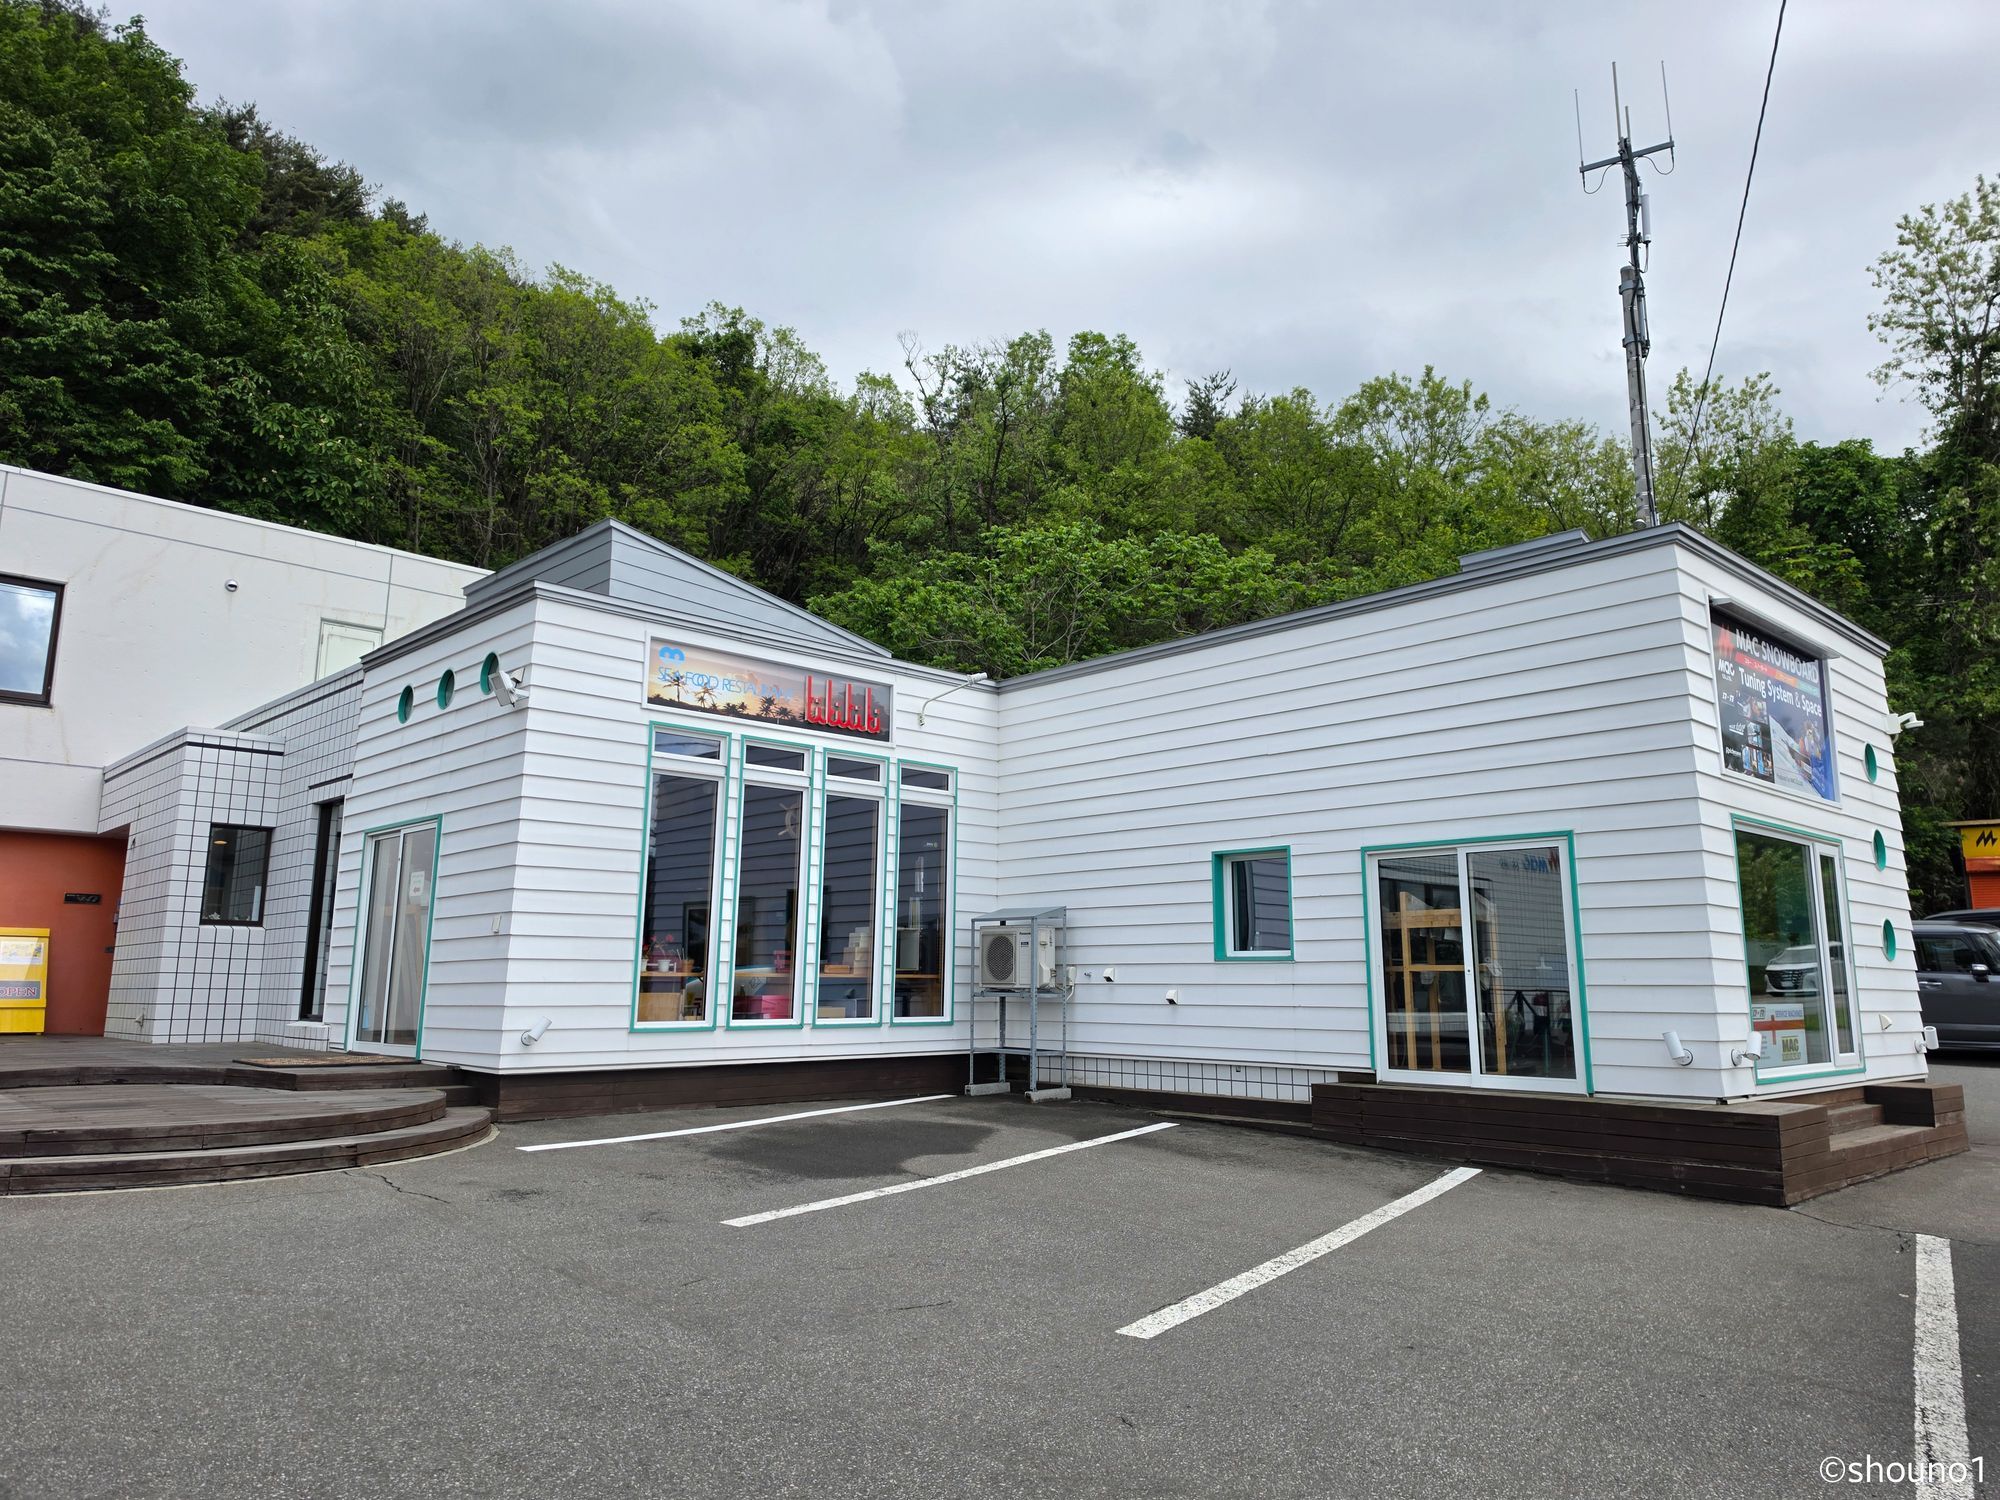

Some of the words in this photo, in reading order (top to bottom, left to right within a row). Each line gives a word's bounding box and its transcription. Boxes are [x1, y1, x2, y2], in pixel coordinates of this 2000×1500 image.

[1735, 629, 1760, 656] MAC
[1761, 641, 1819, 683] SNOWBOARD
[1738, 666, 1767, 699] Tuning
[1767, 679, 1794, 703] System
[1795, 691, 1801, 708] &
[1801, 696, 1822, 717] Space
[0, 986, 37, 997] OPEN
